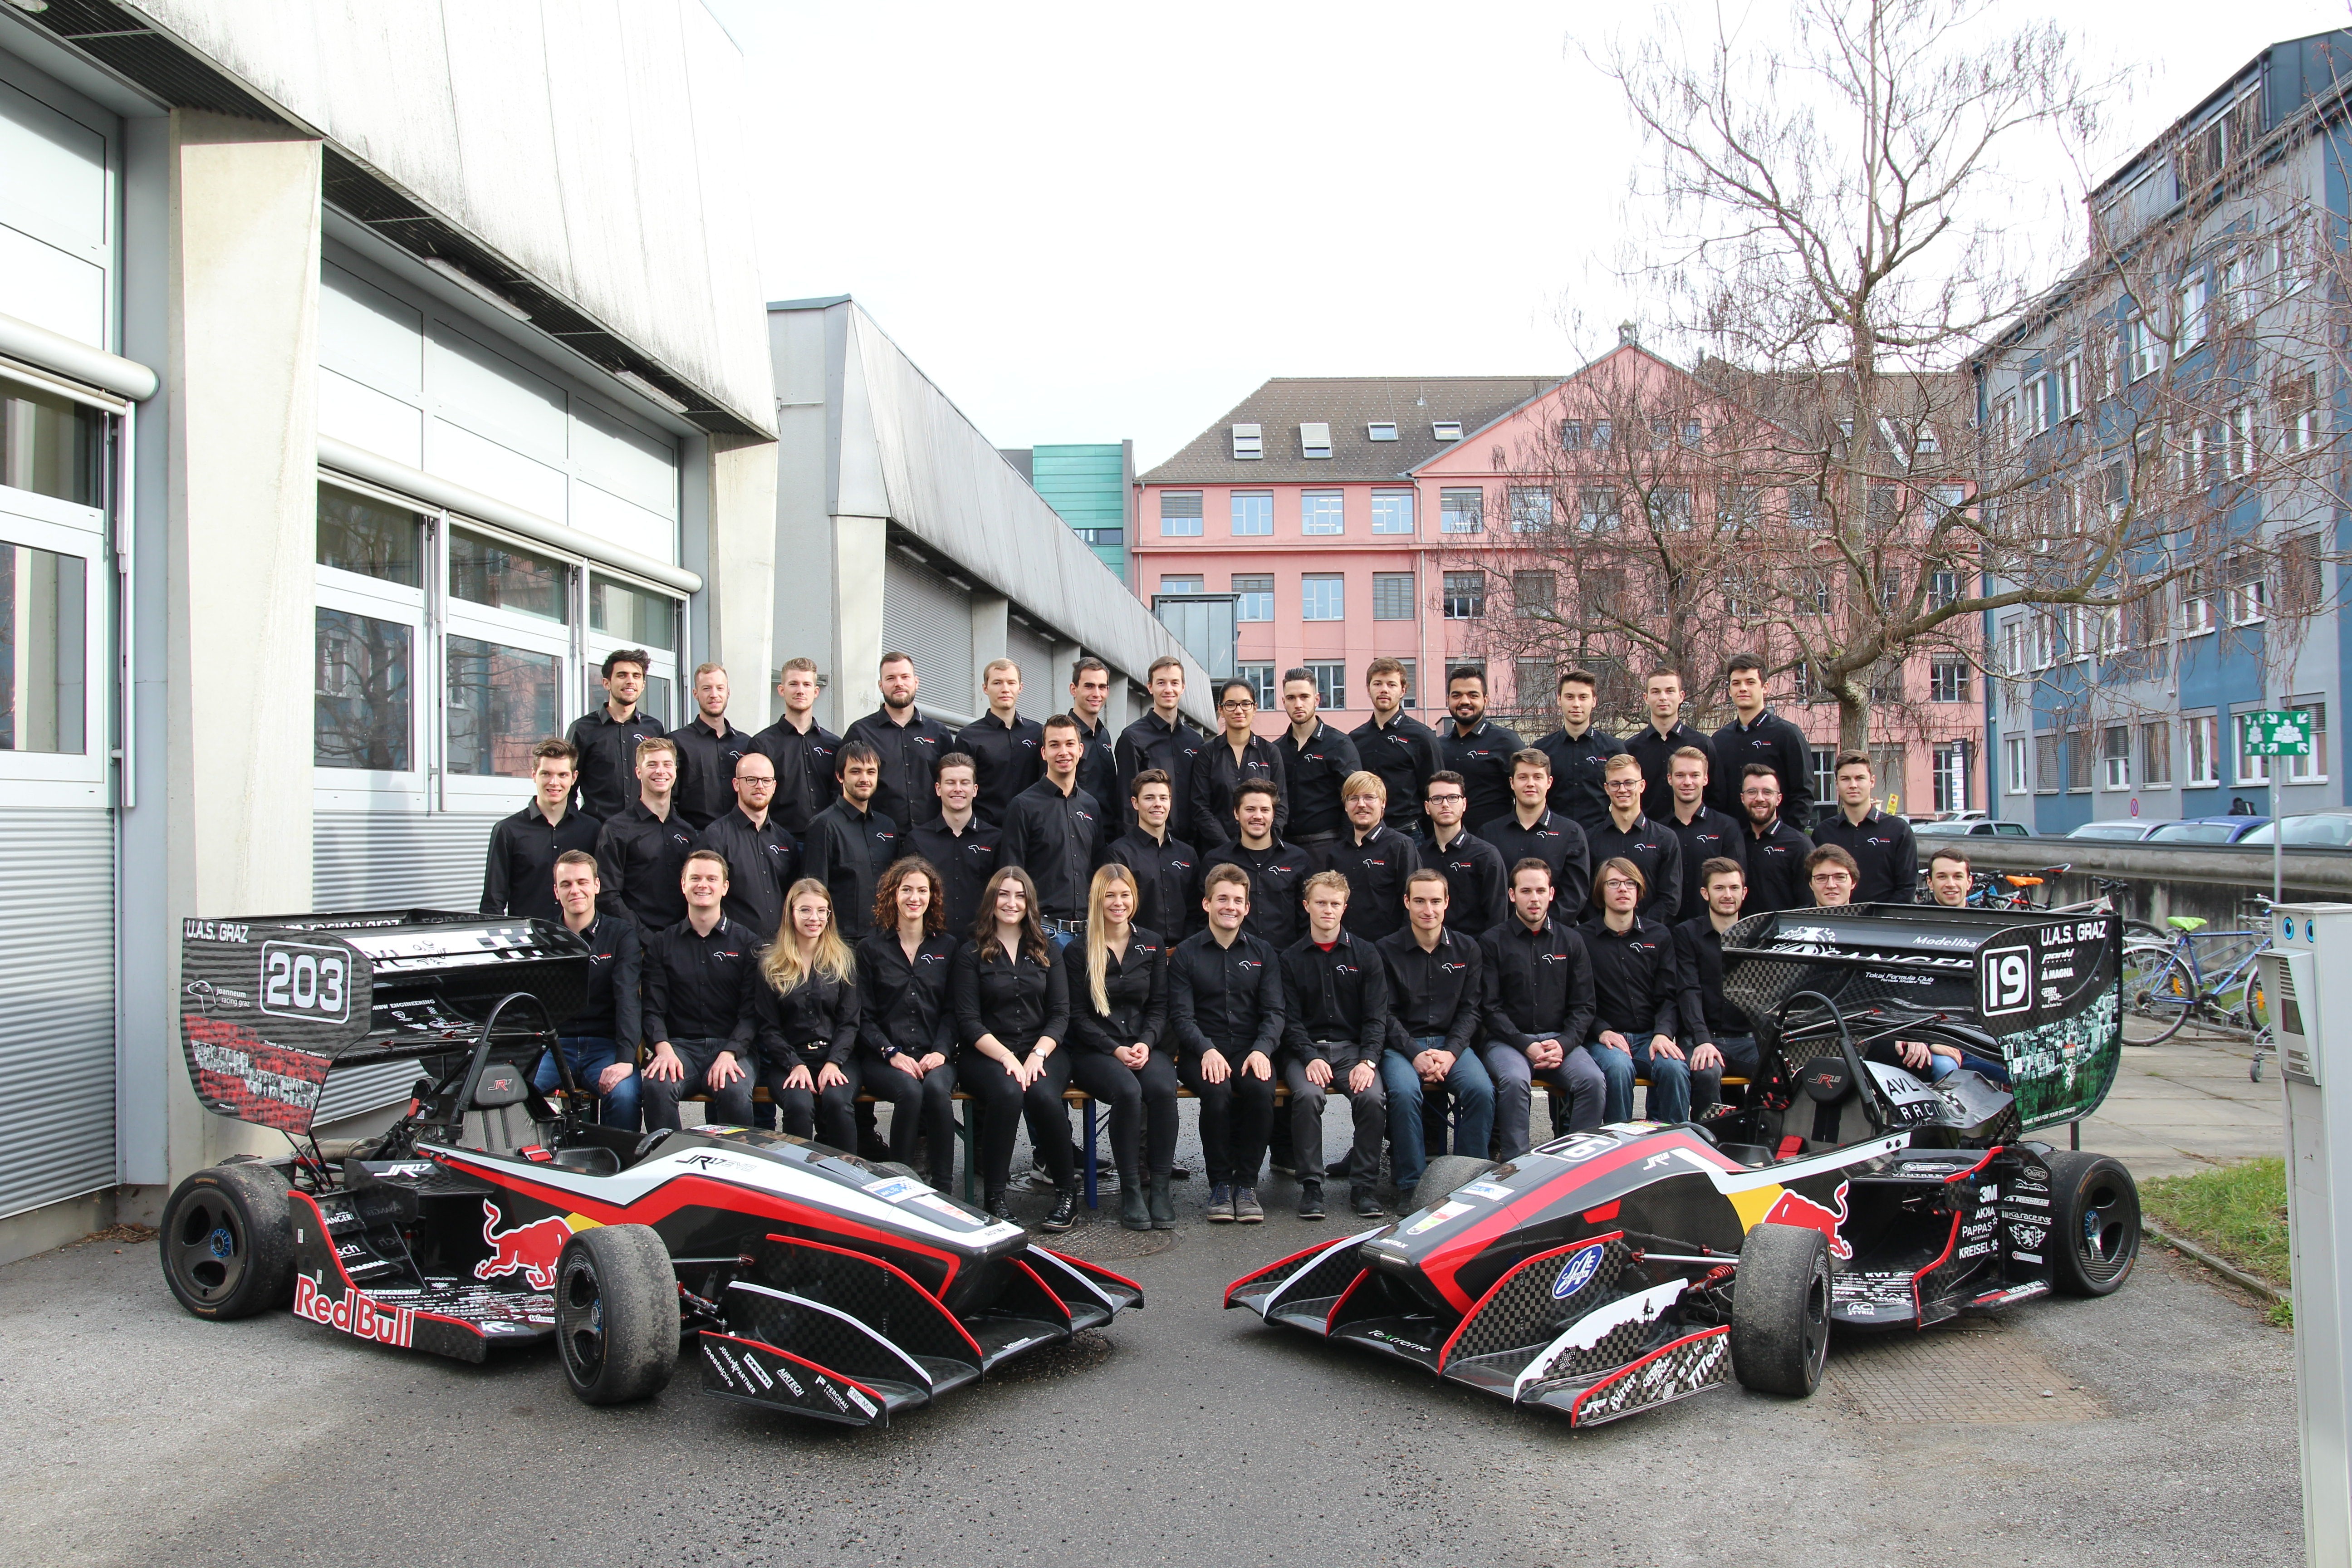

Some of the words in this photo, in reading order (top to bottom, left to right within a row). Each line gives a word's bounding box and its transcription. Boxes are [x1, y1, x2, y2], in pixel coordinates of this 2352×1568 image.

[186, 920, 216, 940] U.A.S.
[219, 924, 249, 943] GRAZ
[2041, 925, 2073, 946] U.A.S.
[2077, 920, 2107, 941] GRAZ
[2041, 948, 2075, 965] pankl
[267, 951, 344, 1012] 203
[1988, 954, 2029, 1008] 19
[2048, 967, 2074, 980] MAGNA
[216, 986, 246, 999] joanneum
[221, 997, 238, 1007] racing
[238, 999, 250, 1008] graz
[389, 999, 435, 1009] ENGINEERING
[306, 1049, 327, 1059] support!
[1886, 1077, 1920, 1097] AVL
[2021, 1117, 2034, 1126] THANK
[2058, 1106, 2076, 1116] SUPPORT!
[373, 1163, 432, 1177] JR17
[880, 1187, 894, 1197] AVL
[1979, 1184, 1998, 1203] 3M
[985, 1227, 1007, 1237] ROTAX
[1962, 1221, 1992, 1238] PAPPAS
[1971, 1233, 1989, 1241] STEIERMARK
[1380, 1238, 1408, 1249] ROTAX
[1959, 1241, 1990, 1259] KREISEL
[294, 1273, 355, 1333] Red
[353, 1294, 415, 1348] Bull
[1367, 1329, 1431, 1352] TeXtreme
[704, 1344, 734, 1387] voestalpine
[776, 1368, 805, 1397] AIRTECH
[823, 1389, 846, 1413] ENGINEERING
[825, 1384, 849, 1409] FERCHAU
[848, 1388, 861, 1403] CNC
[862, 1400, 876, 1415] Mair
[1579, 1398, 1608, 1416] JR18
